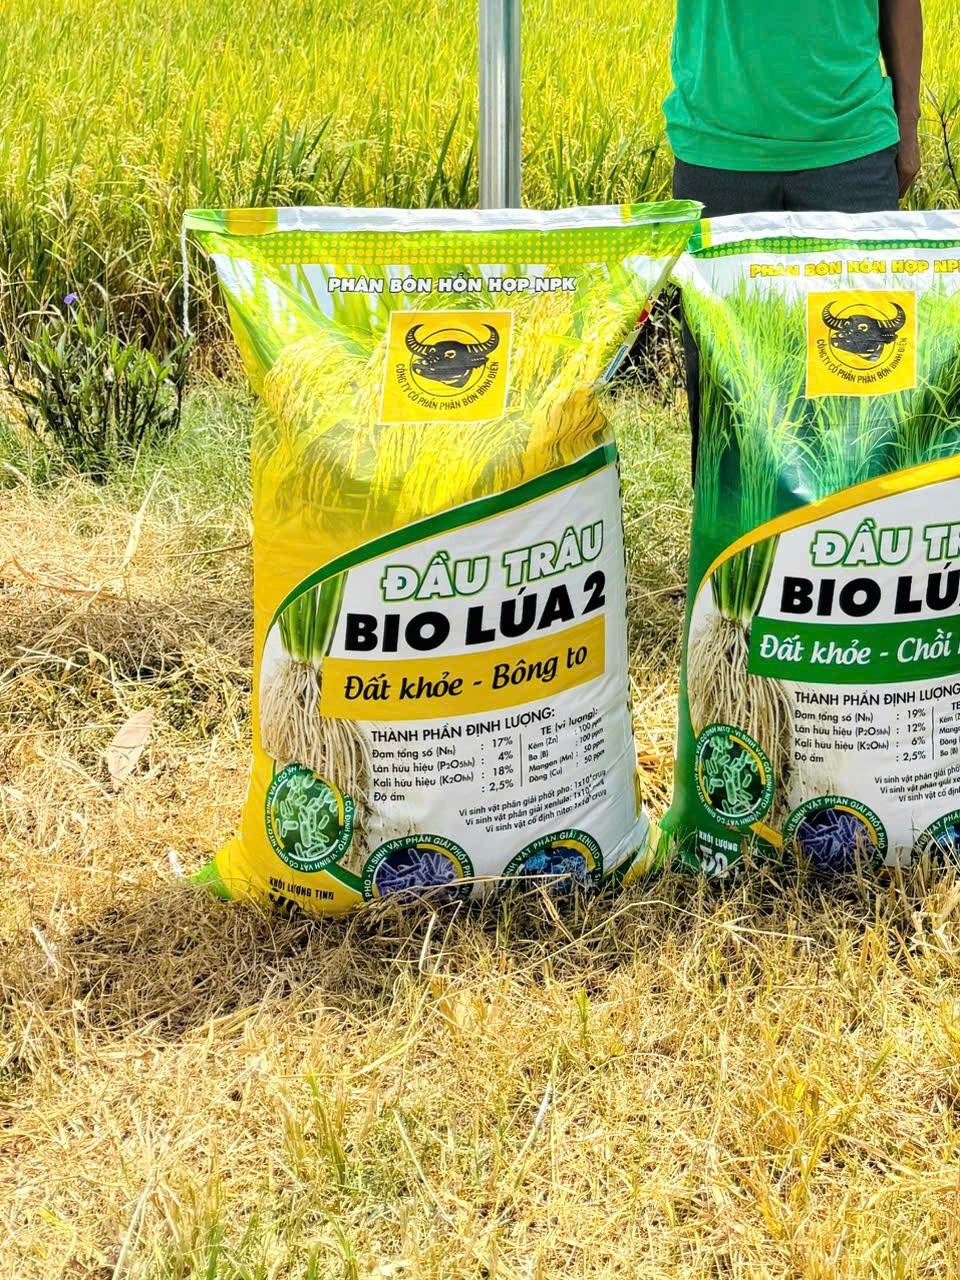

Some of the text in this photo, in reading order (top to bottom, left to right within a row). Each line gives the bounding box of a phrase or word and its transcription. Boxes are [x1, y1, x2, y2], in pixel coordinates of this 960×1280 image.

[328, 272, 577, 297] PHÂN BÓN HỖN HỢP NPK
[380, 520, 604, 602] ĐẦU TRÂU
[810, 517, 913, 567] ĐẦU
[344, 570, 606, 652] BIO LÚA 2
[780, 576, 882, 617] BIO
[759, 633, 805, 663] Đất
[810, 637, 872, 666] khỏe
[897, 628, 952, 664] Chồi
[344, 645, 588, 701] Đất khỏe Bông to
[371, 708, 556, 743] THÀNH PHẦN ĐỊNH LƯỢNG:
[907, 709, 926, 718] 19%
[492, 737, 513, 748] 17%
[489, 779, 515, 792] 2,5%
